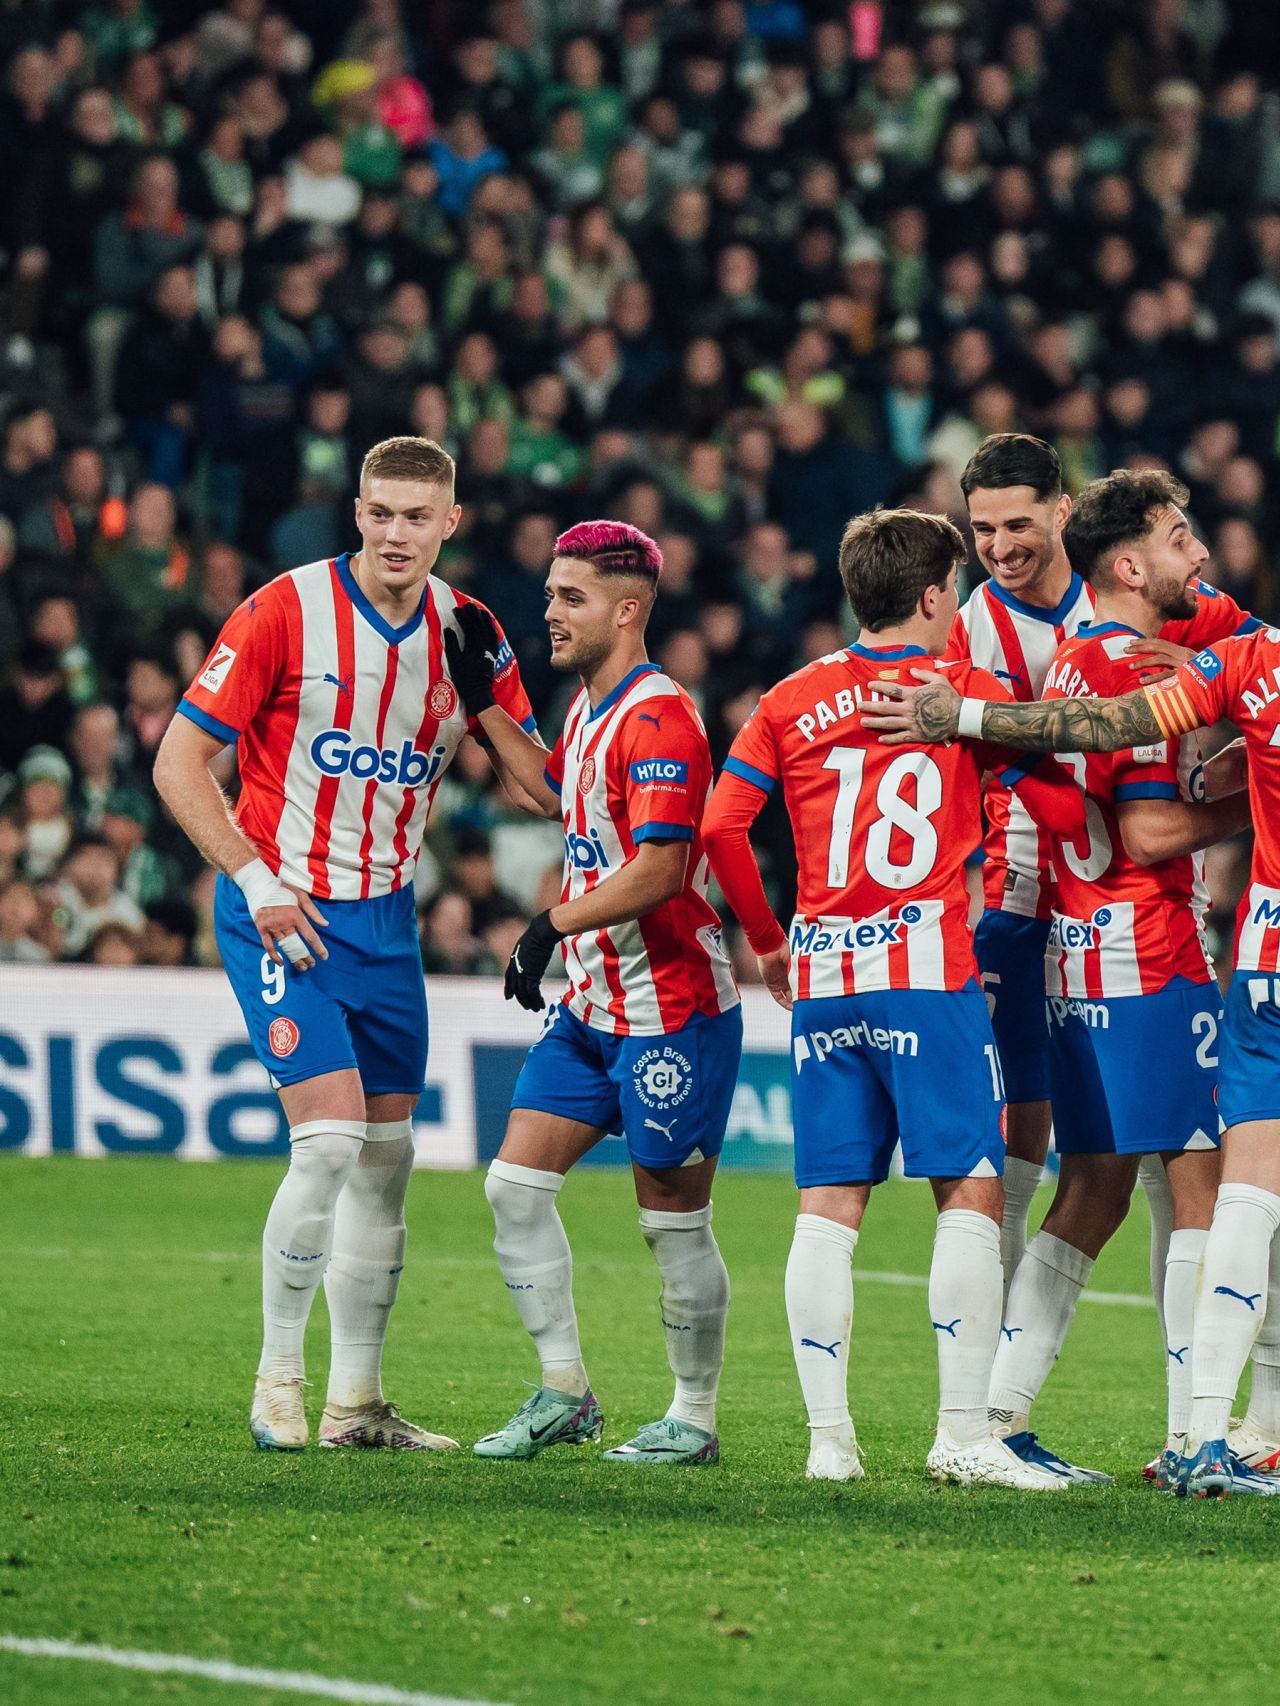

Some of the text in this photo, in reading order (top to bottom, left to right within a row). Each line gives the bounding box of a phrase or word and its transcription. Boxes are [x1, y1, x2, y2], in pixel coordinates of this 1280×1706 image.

[310, 729, 447, 787] Gosbi
[821, 745, 943, 890] 18
[260, 951, 286, 1005] 9
[632, 1046, 692, 1074] Costa Brava
[809, 1020, 918, 1063] parlem
[1191, 1010, 1225, 1069] 2
[633, 1077, 693, 1110] Pirineu de Girona
[652, 1071, 673, 1089] G!
